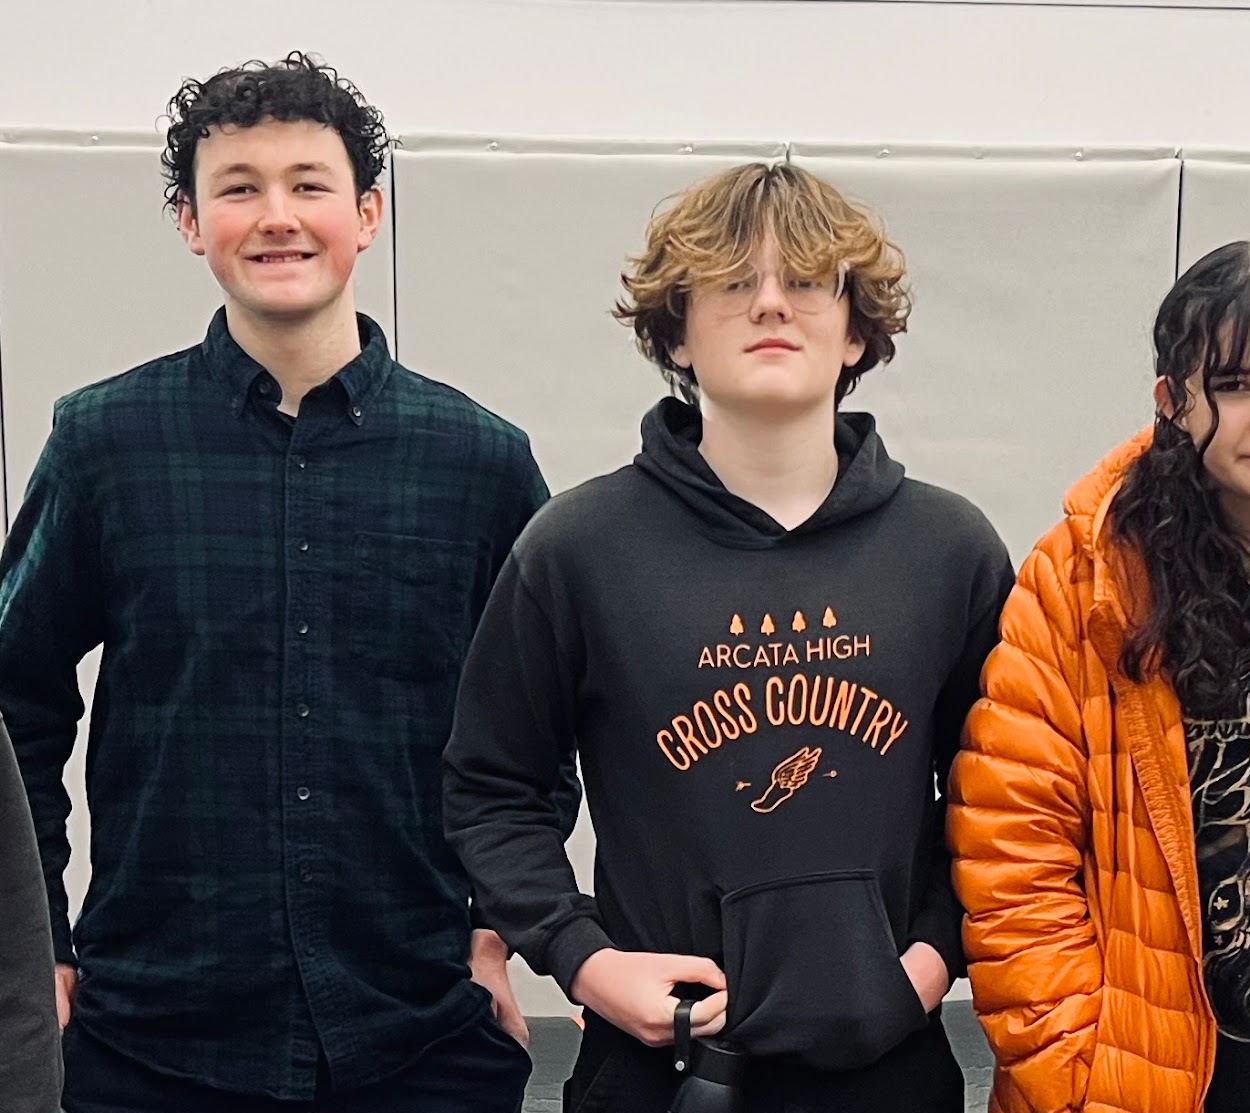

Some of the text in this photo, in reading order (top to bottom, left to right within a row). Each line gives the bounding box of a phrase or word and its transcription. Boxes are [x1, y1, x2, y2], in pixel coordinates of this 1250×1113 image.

[698, 635, 870, 669] ARCATA HIGH
[656, 673, 909, 771] CROSS COUNTRY
